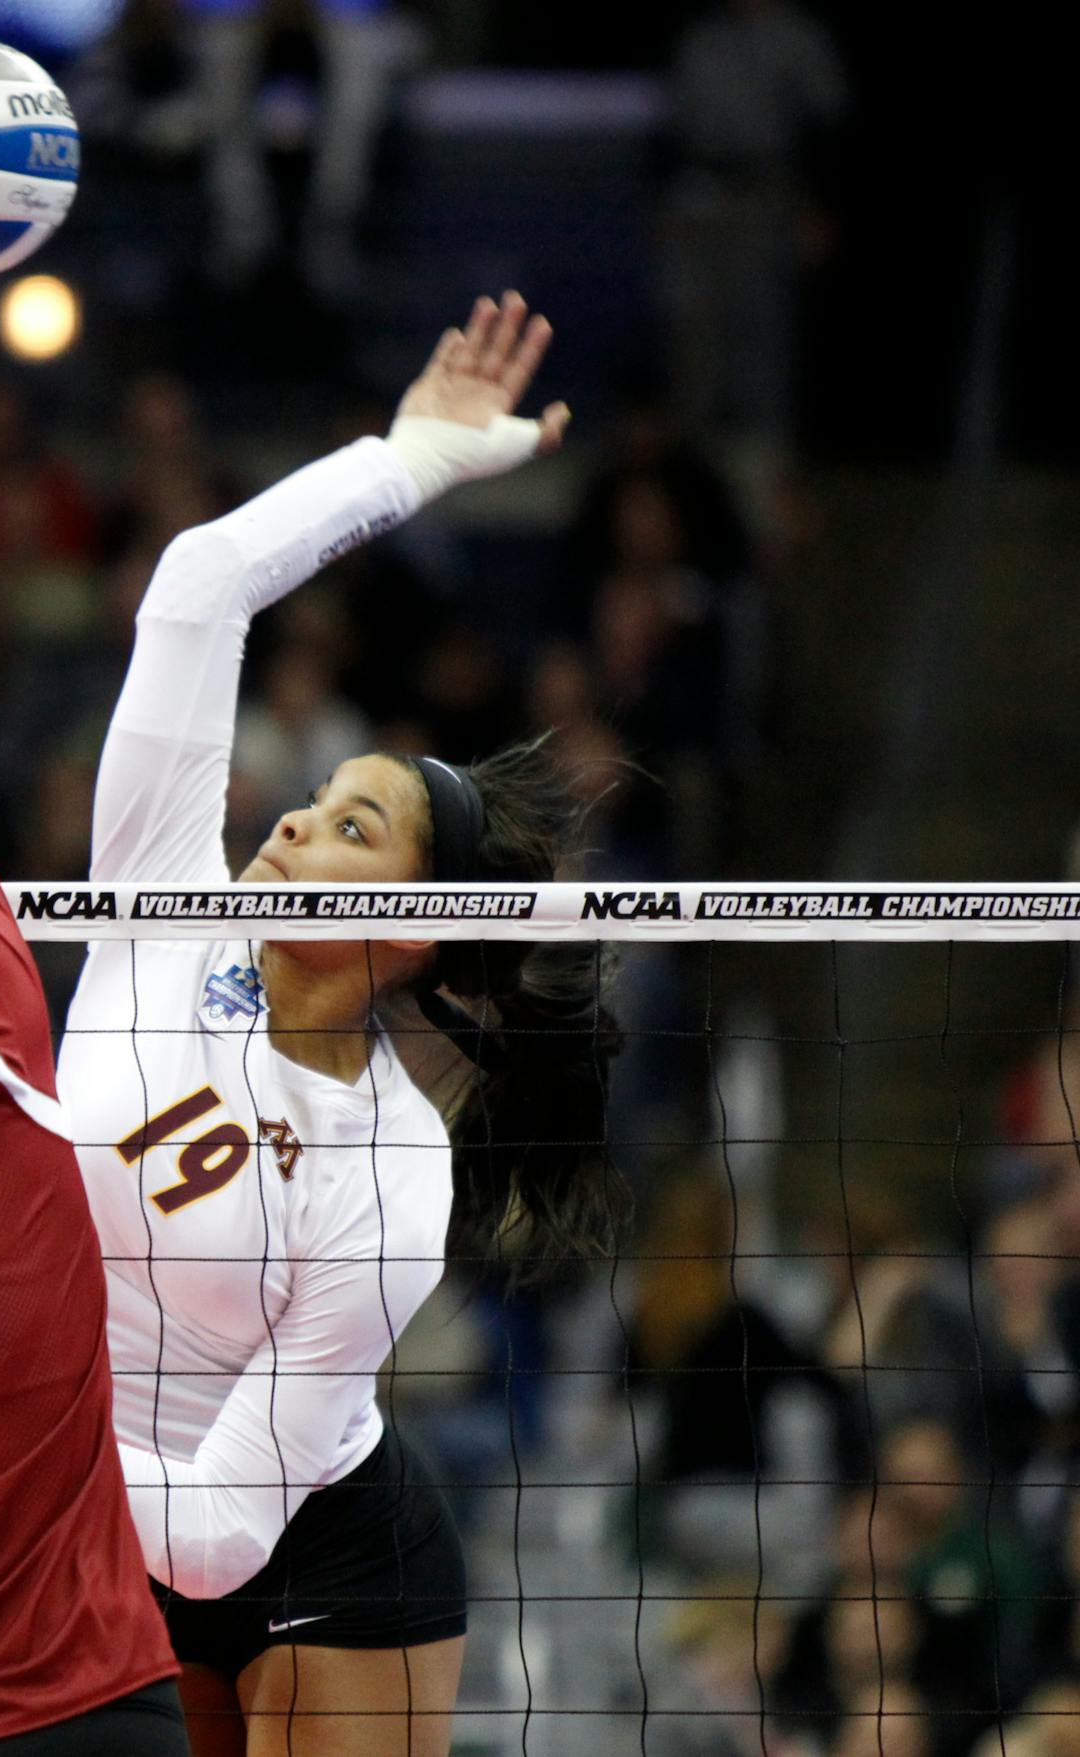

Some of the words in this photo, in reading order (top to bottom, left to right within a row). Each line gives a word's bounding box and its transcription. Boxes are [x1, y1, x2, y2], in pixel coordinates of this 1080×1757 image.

[17, 891, 117, 919] NCAA
[139, 895, 308, 917] VOLLEYBALL
[316, 895, 532, 917] CHAMPIONSHIP
[580, 891, 681, 920] NCAA
[704, 895, 874, 918] VOLLEYBALL
[882, 895, 1080, 918] CHAMPIONSHI
[115, 1083, 251, 1217] 19
